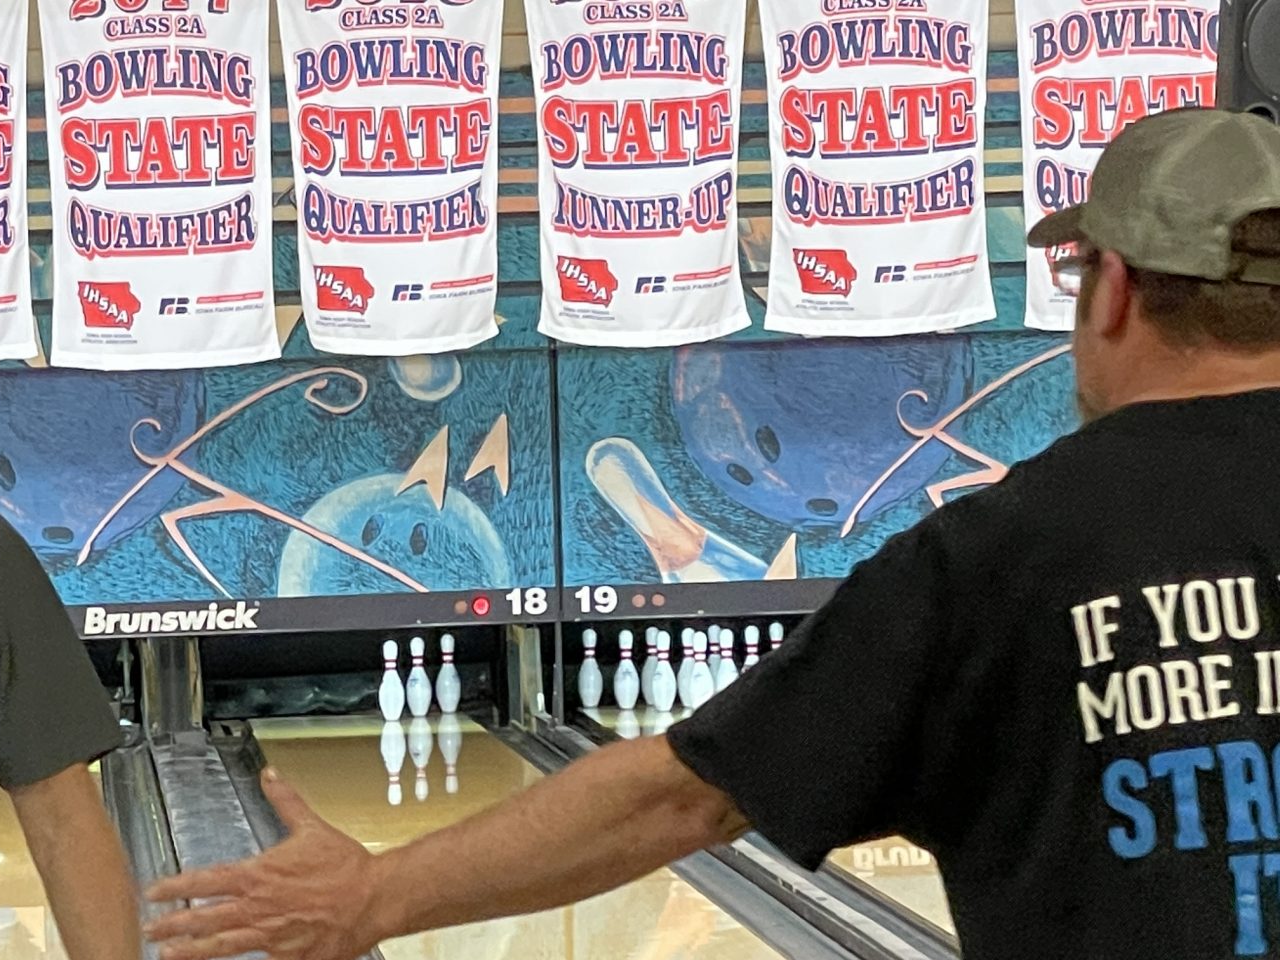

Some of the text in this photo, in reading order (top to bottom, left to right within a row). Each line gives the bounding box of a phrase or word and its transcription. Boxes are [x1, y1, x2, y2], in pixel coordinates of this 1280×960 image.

[105, 15, 206, 38] CLASS 2A
[340, 6, 442, 28] CLASS 2A
[585, 2, 686, 22] CLASS 2A
[295, 38, 487, 95] BOWLING
[543, 30, 727, 82] BOWLING
[778, 18, 972, 77] BOWLING
[58, 48, 253, 111] BOWLING
[297, 97, 491, 175] STATE
[541, 90, 733, 167] STATE
[779, 78, 977, 158] STATE
[60, 112, 256, 189] STATE
[303, 180, 487, 239] QUALIFIER
[783, 157, 975, 222] QUALIFIER
[69, 192, 256, 256] QUALIFIER
[316, 268, 363, 307] IHSAA
[560, 259, 609, 300] IHSAA
[797, 251, 846, 290] IHSAA
[83, 284, 129, 323] IHSAA
[84, 601, 259, 634] Brunswick
[506, 588, 547, 615] 18
[575, 586, 618, 613] 19
[1070, 577, 1260, 667] IF YOU
[1077, 655, 1239, 743] MORE
[1102, 739, 1280, 859] STR
